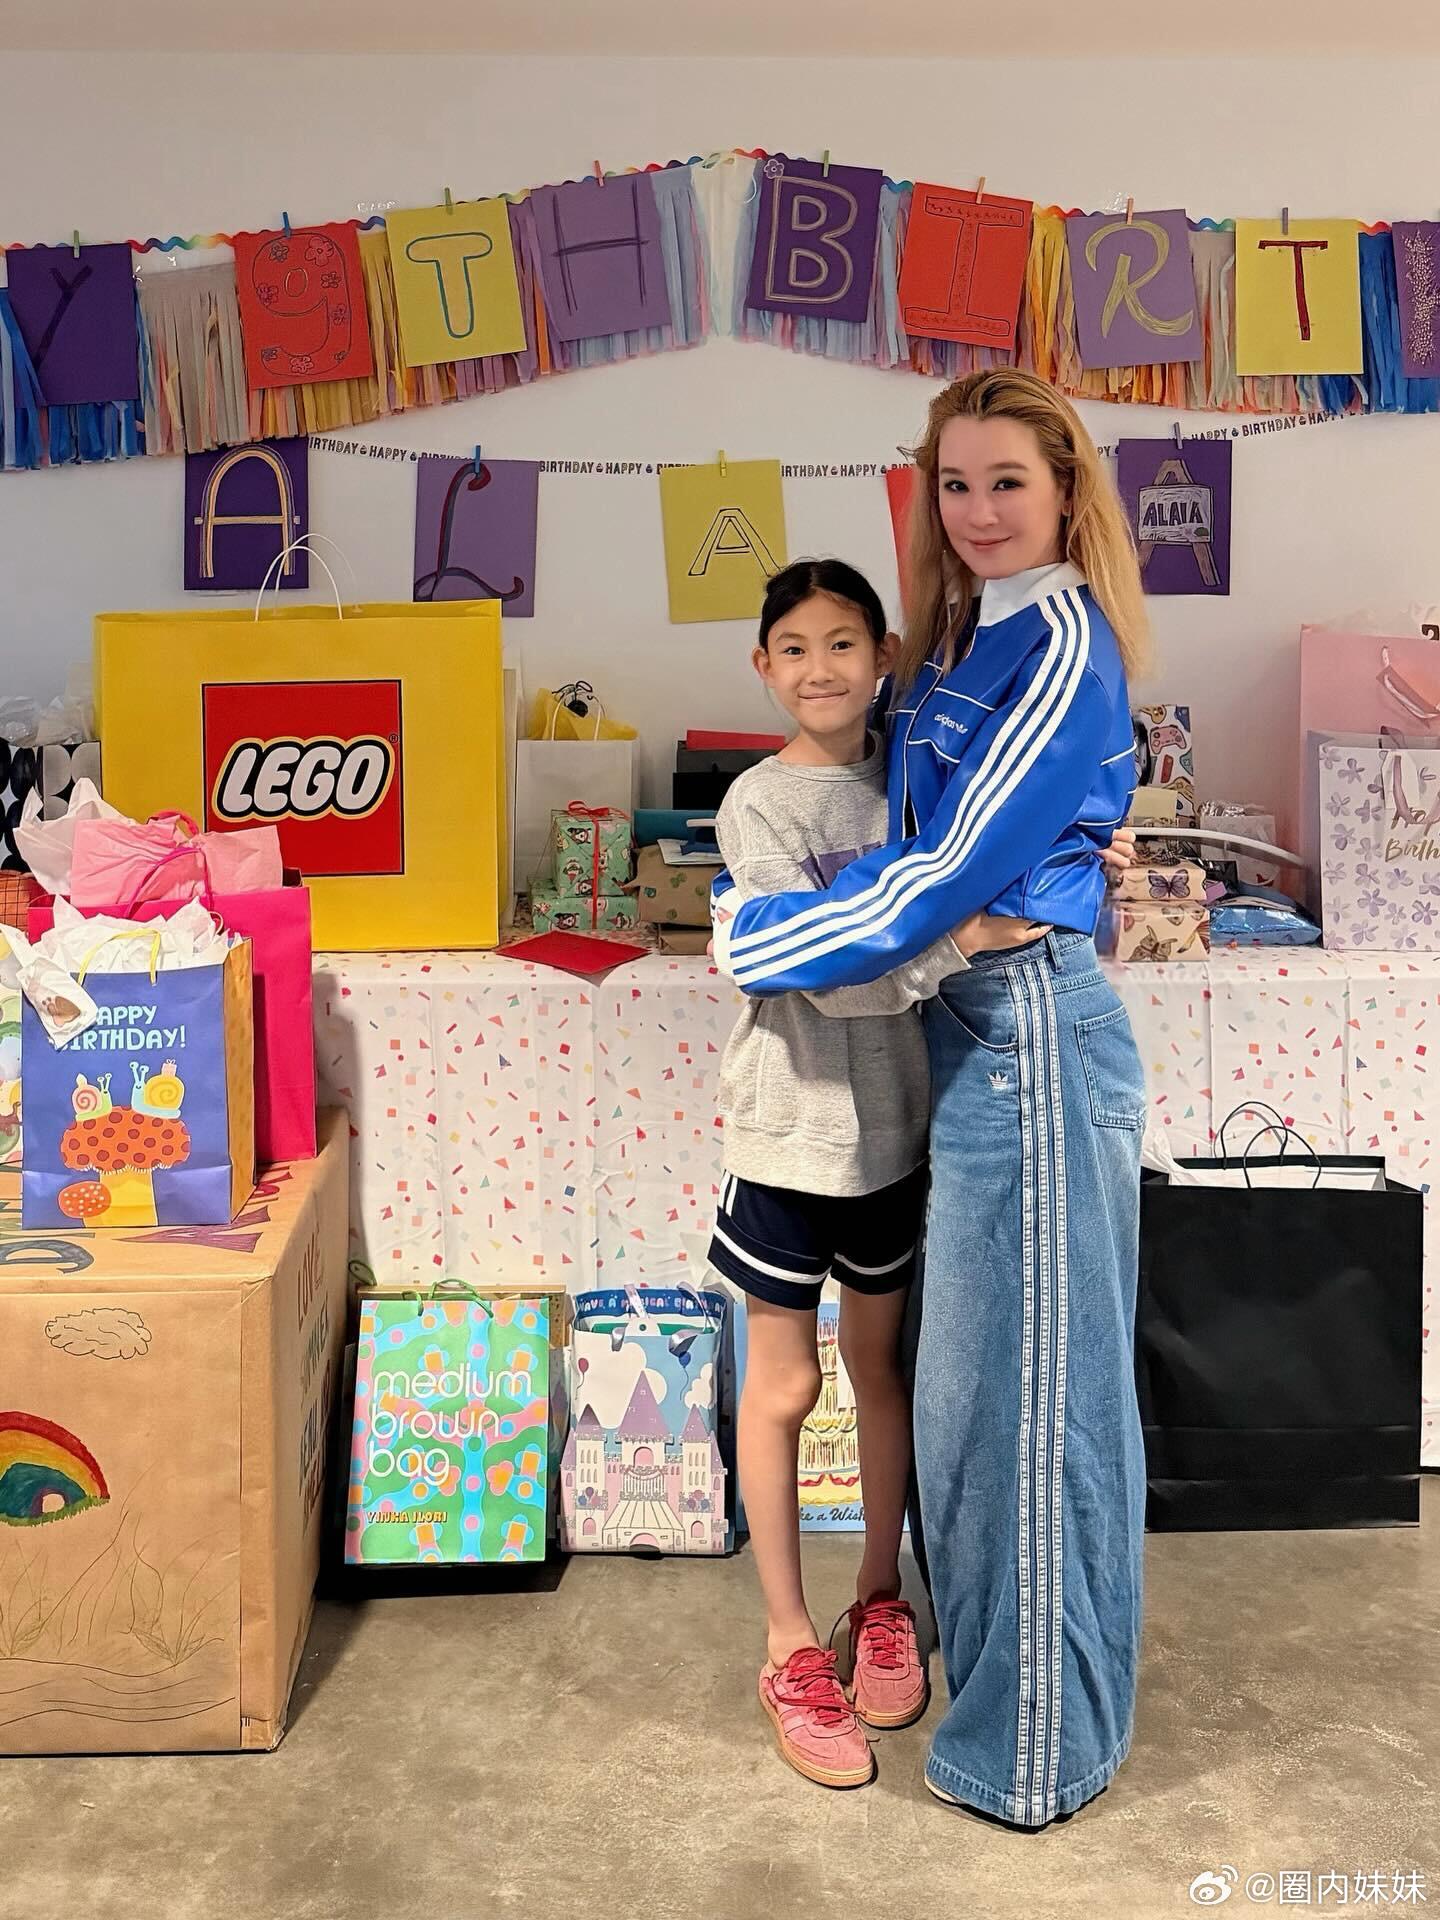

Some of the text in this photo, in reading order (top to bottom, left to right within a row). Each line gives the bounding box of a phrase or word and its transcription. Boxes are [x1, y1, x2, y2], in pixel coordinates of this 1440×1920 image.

[309, 437, 358, 455] IRTHDAY
[369, 445, 407, 462] HAPPY
[539, 461, 594, 474] BIRTHDAY
[605, 462, 642, 475] HAPPY
[781, 464, 828, 477] IRTHDAY
[840, 464, 876, 477] HAPPY
[1242, 417, 1297, 437] BIRTHDAY
[1143, 501, 1203, 527] ALAIA
[217, 739, 390, 817] LEGO
[96, 1005, 157, 1026] APPY
[52, 1025, 186, 1050] IRTHDAY!
[374, 1363, 532, 1398] medium
[371, 1403, 500, 1439] brown
[369, 1441, 450, 1487] bag
[367, 1511, 448, 1524] YINKA ILORI
